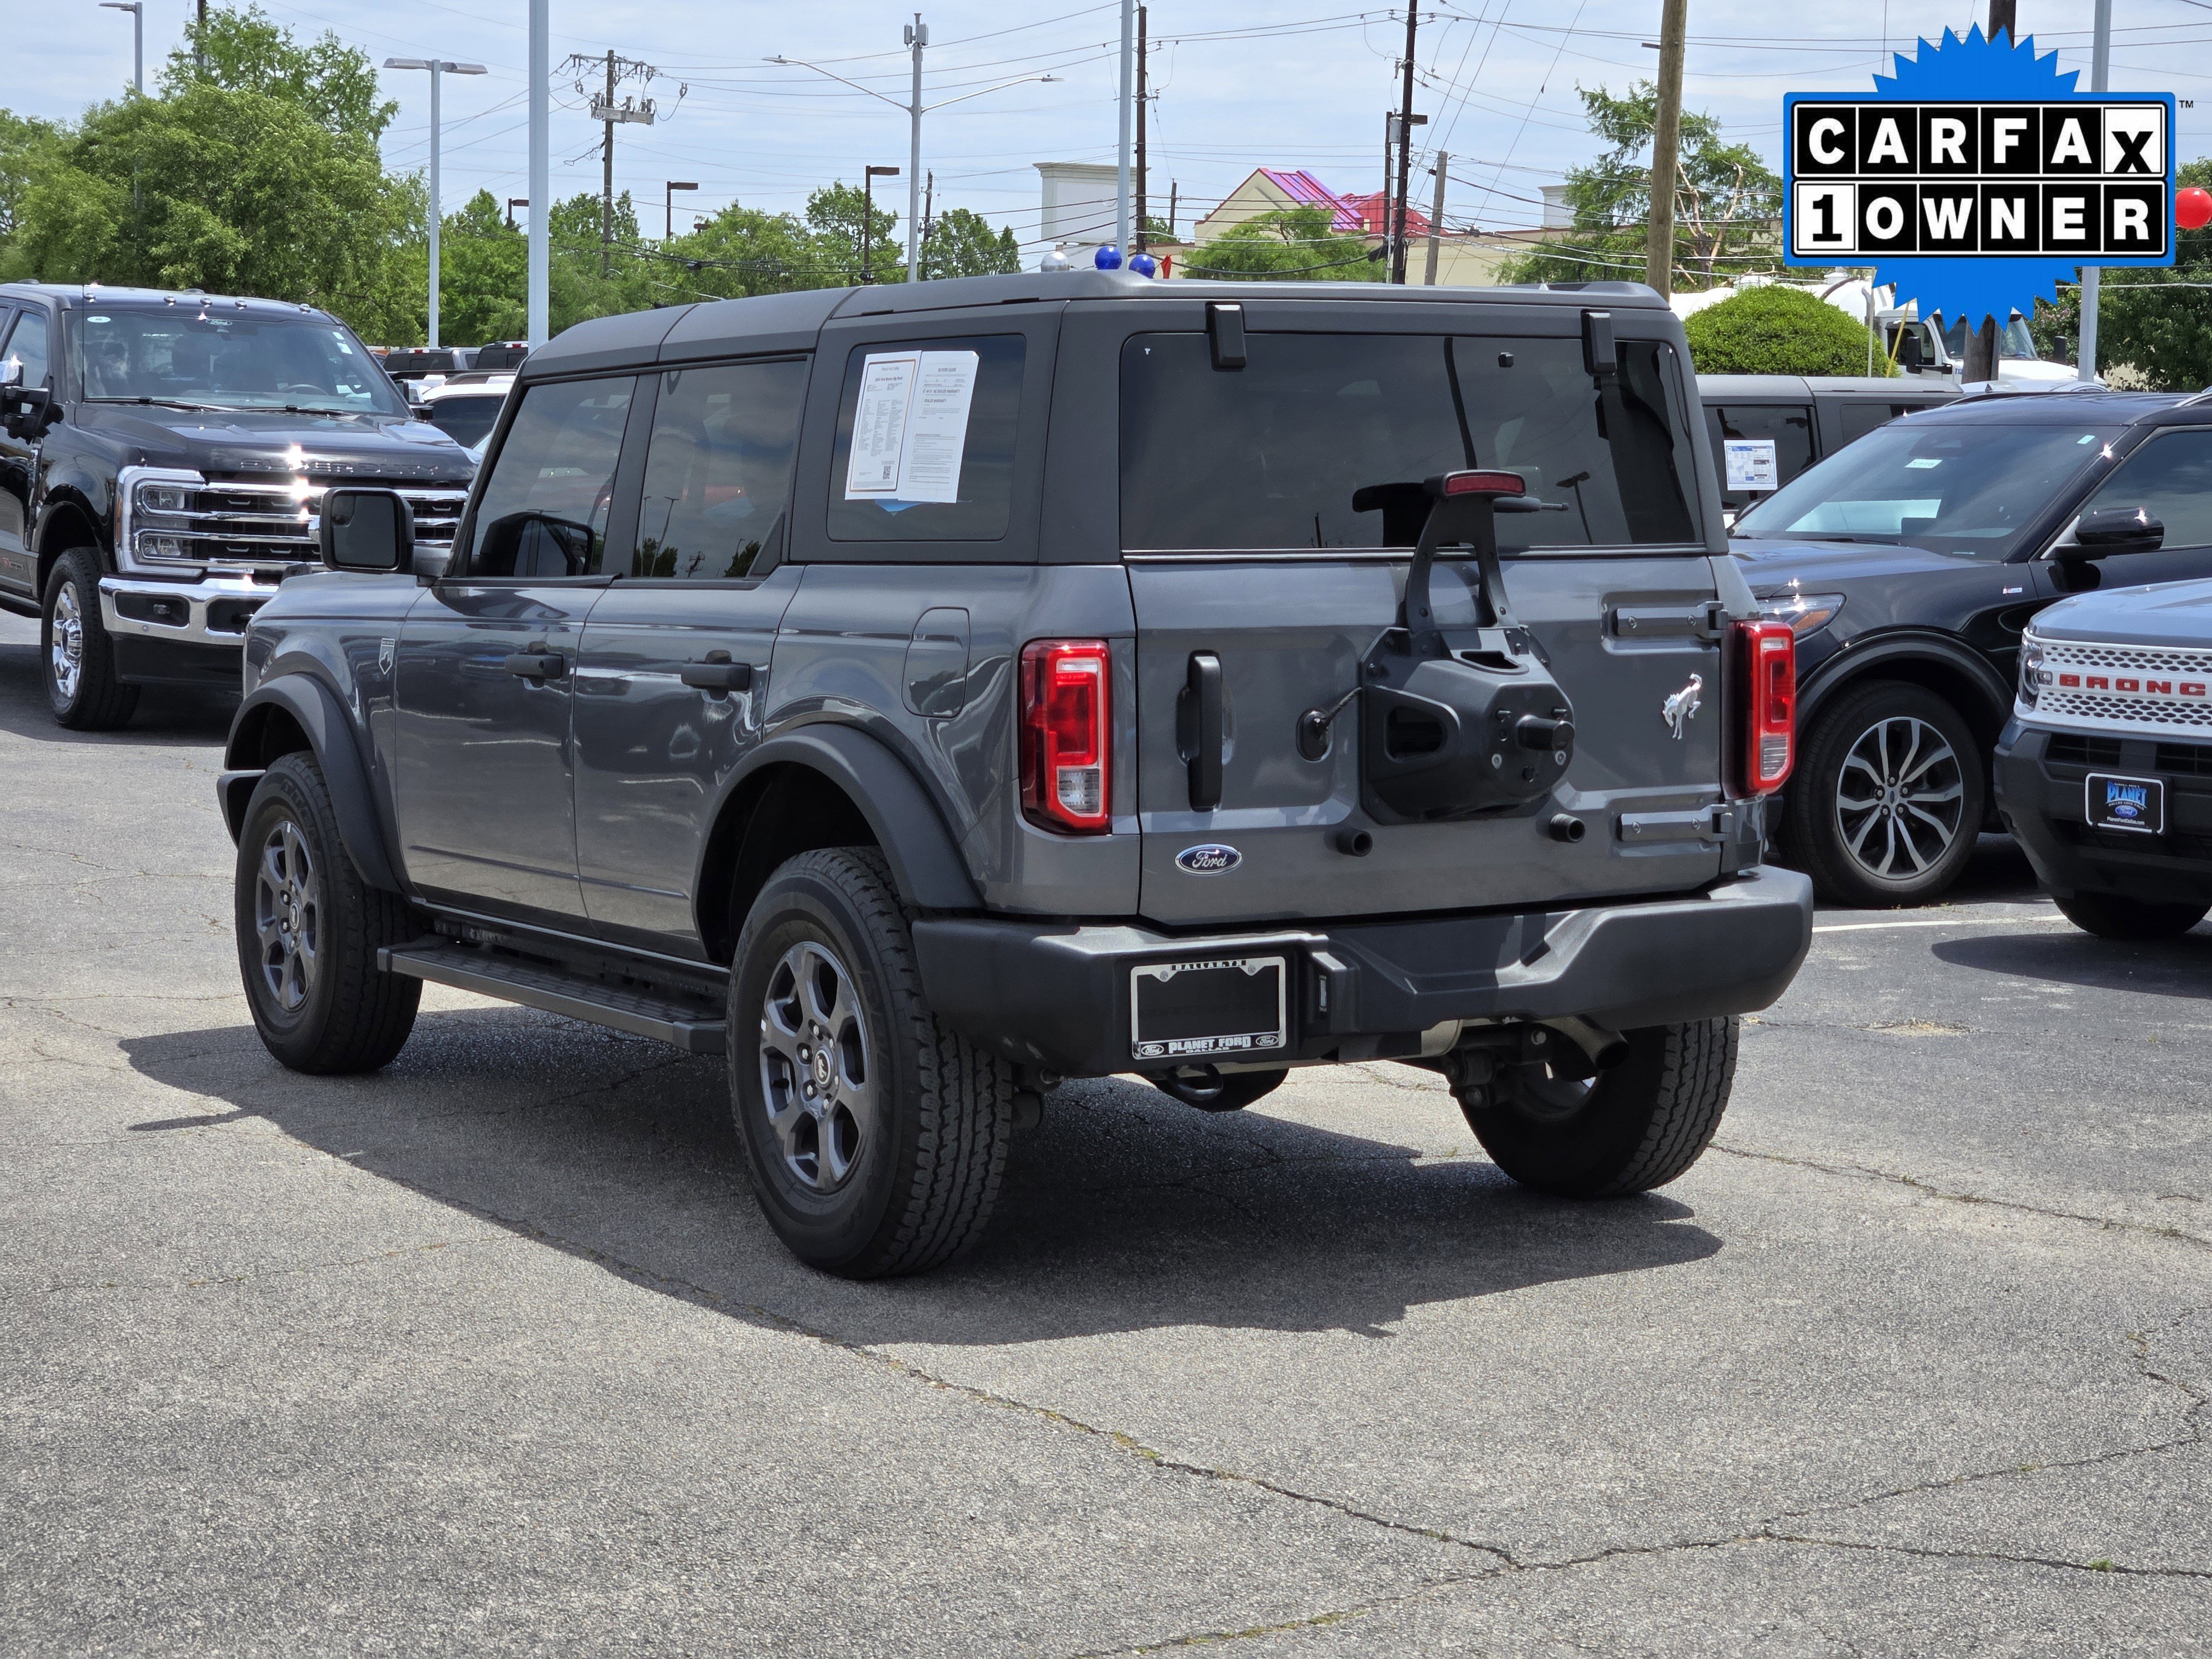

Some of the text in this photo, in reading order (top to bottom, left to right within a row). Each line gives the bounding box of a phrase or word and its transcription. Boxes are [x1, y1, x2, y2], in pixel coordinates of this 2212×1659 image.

[359, 463, 440, 476] DUTY
[2059, 674, 2206, 696] BRONC
[2107, 780, 2147, 806] PLANET
[1192, 850, 1228, 868] Ford
[1145, 1045, 1161, 1054] Ford
[1168, 1036, 1251, 1054] PLANET FORD
[1260, 1036, 1274, 1045] Ford
